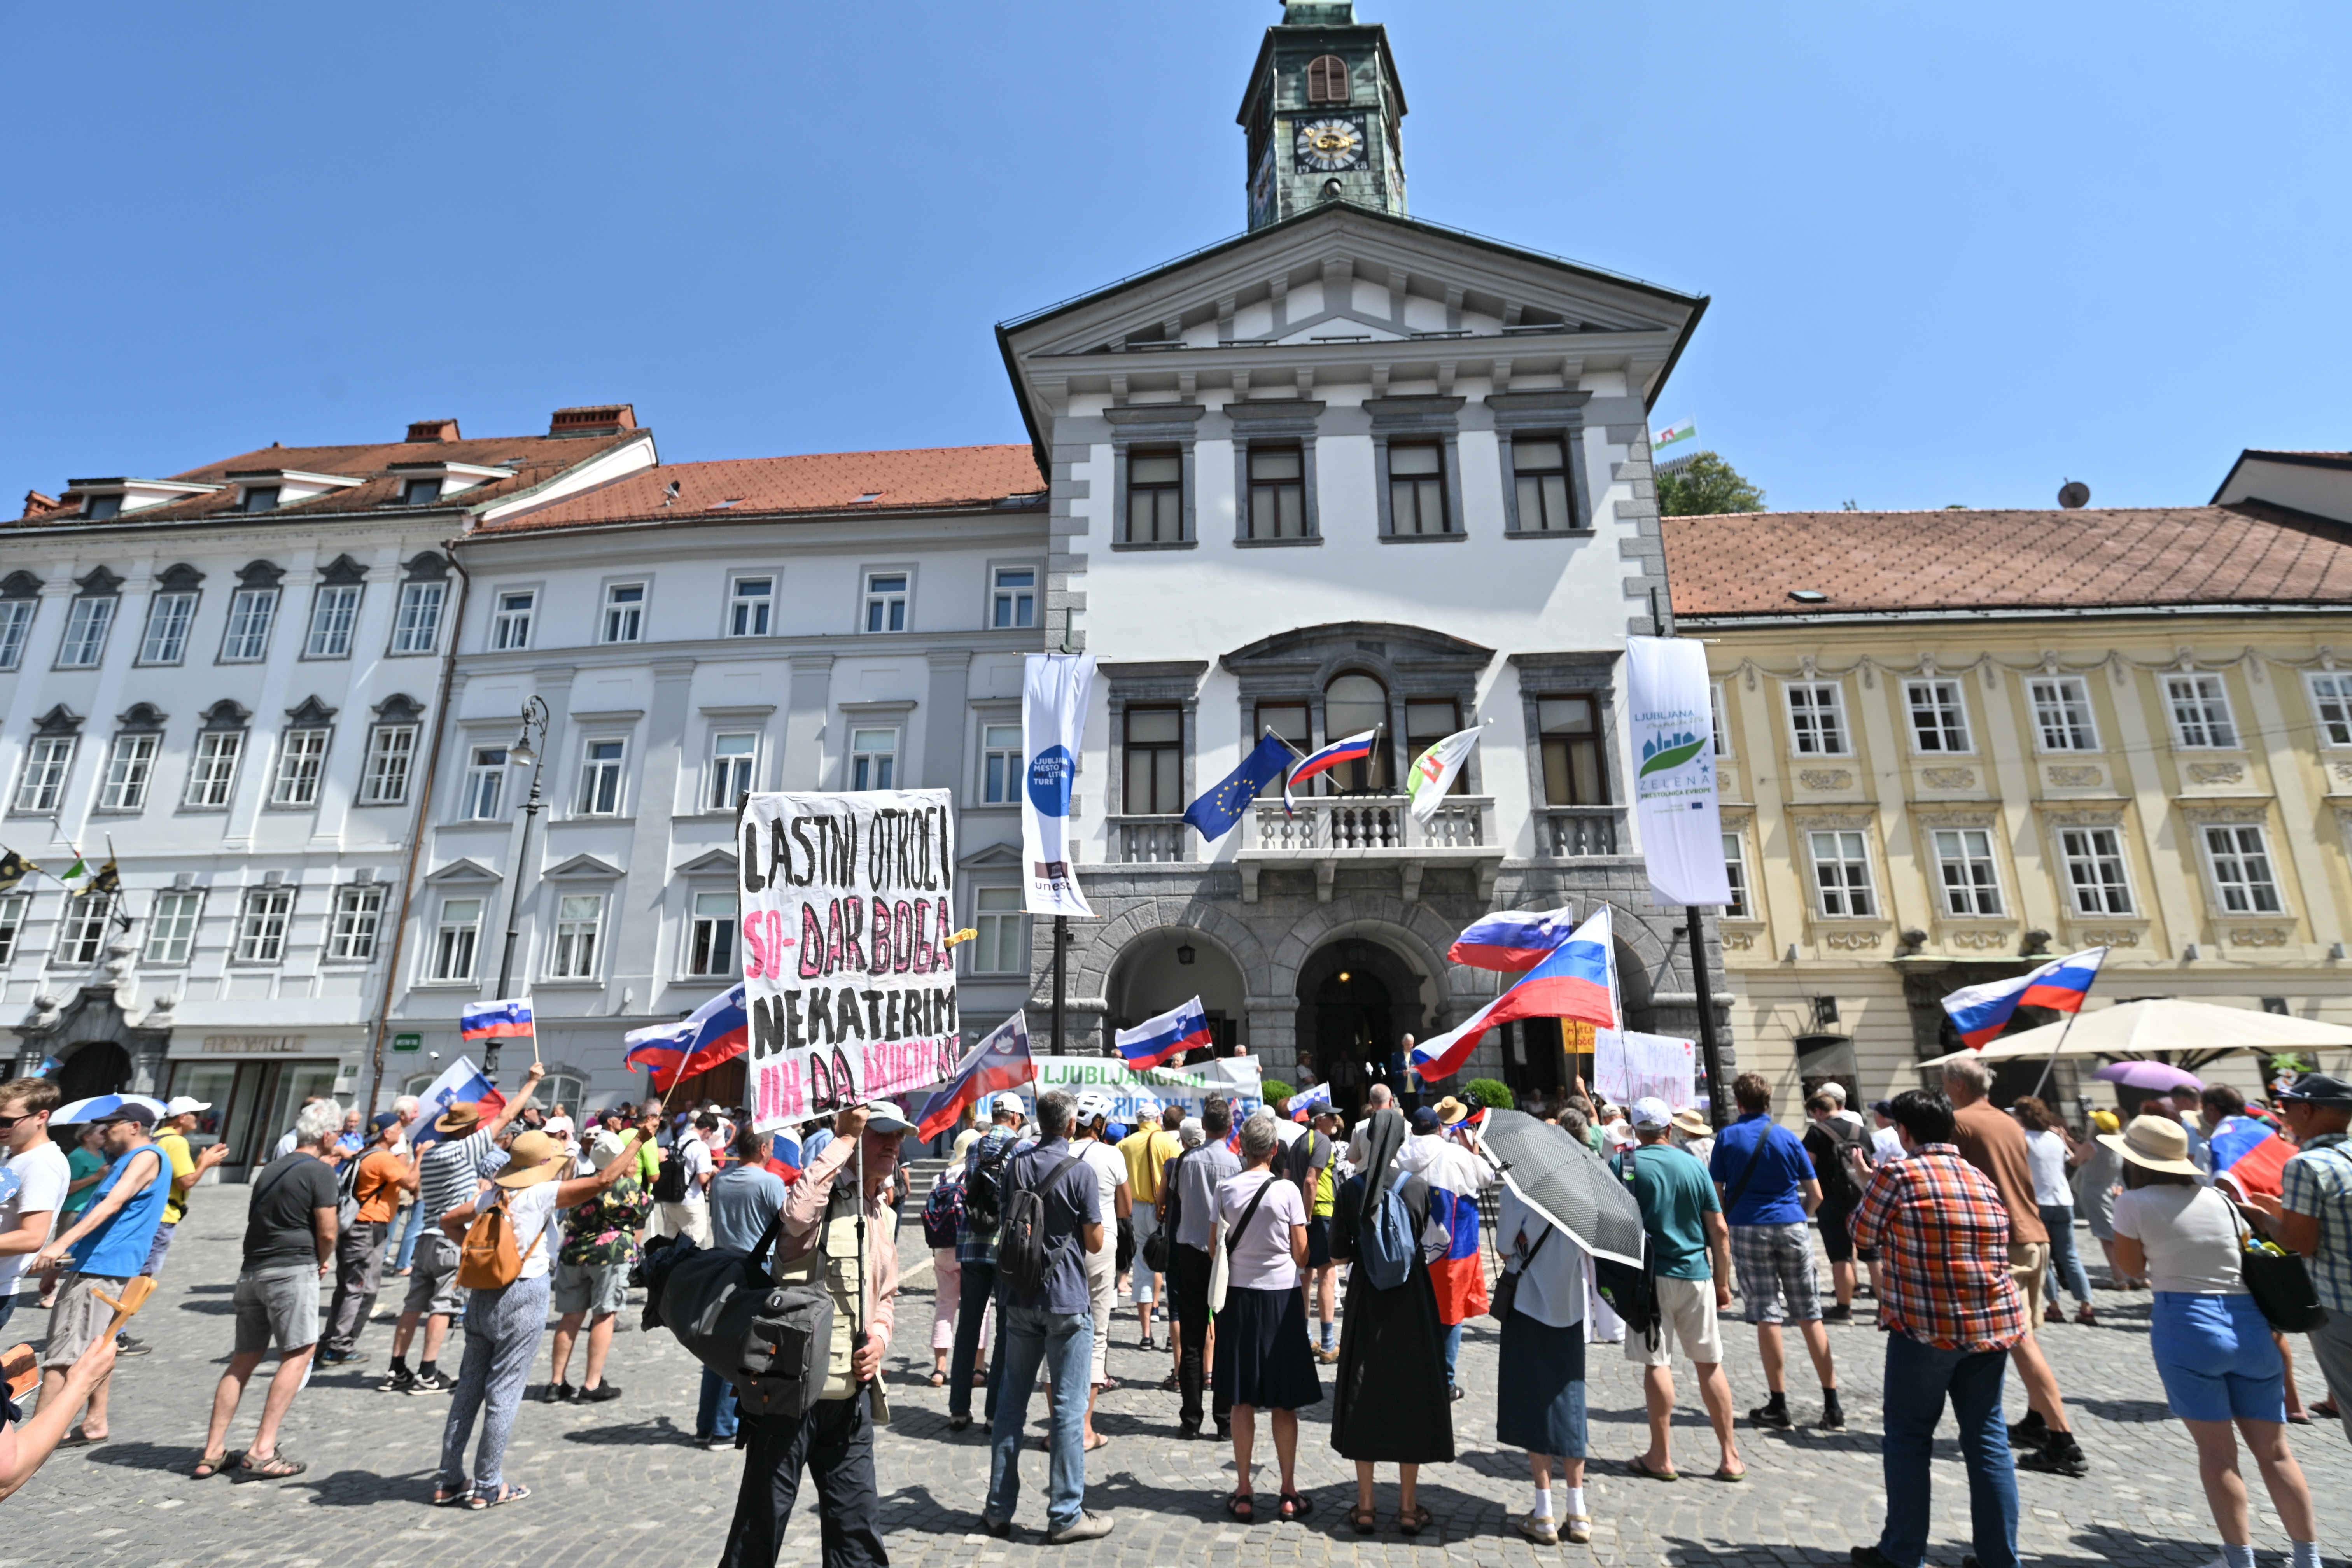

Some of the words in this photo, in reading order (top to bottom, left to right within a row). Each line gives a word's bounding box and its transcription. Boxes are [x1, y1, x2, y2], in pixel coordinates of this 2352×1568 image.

[1635, 710, 1695, 722] LJUBLJANA
[1640, 775, 1710, 791] ZELENA
[1641, 790, 1684, 799] PRESTOLNICA
[1685, 787, 1711, 795] EVROPE
[744, 812, 858, 893] LASTNI
[868, 804, 950, 892] OTROCI
[753, 985, 956, 1060] NEKATERIM
[1599, 1036, 1642, 1066] HVAA
[1595, 1074, 1612, 1090] ZA
